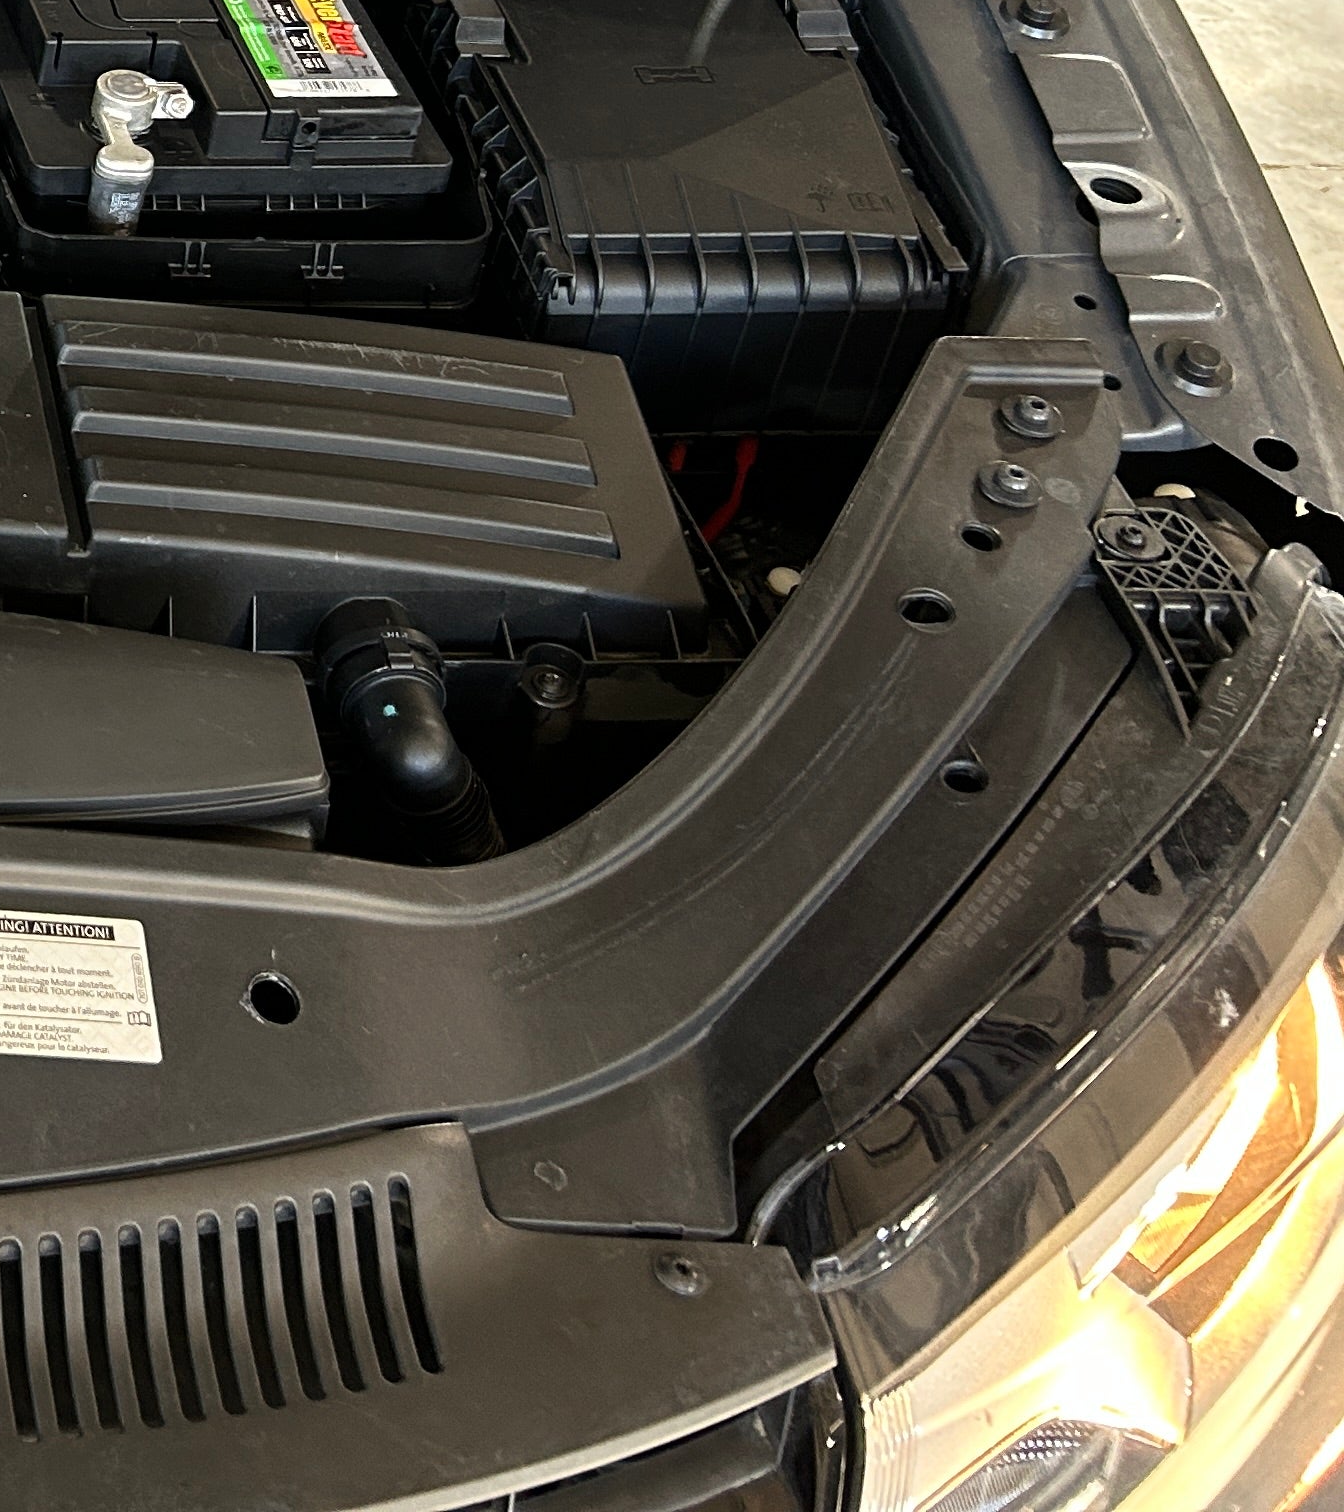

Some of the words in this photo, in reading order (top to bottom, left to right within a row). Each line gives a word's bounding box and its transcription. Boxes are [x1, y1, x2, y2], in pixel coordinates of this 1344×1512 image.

[32, 922, 110, 939] ATTENTION!
[18, 985, 50, 995] BEFORE
[52, 987, 95, 998] TOUCHING
[96, 990, 135, 1000] IGNITION
